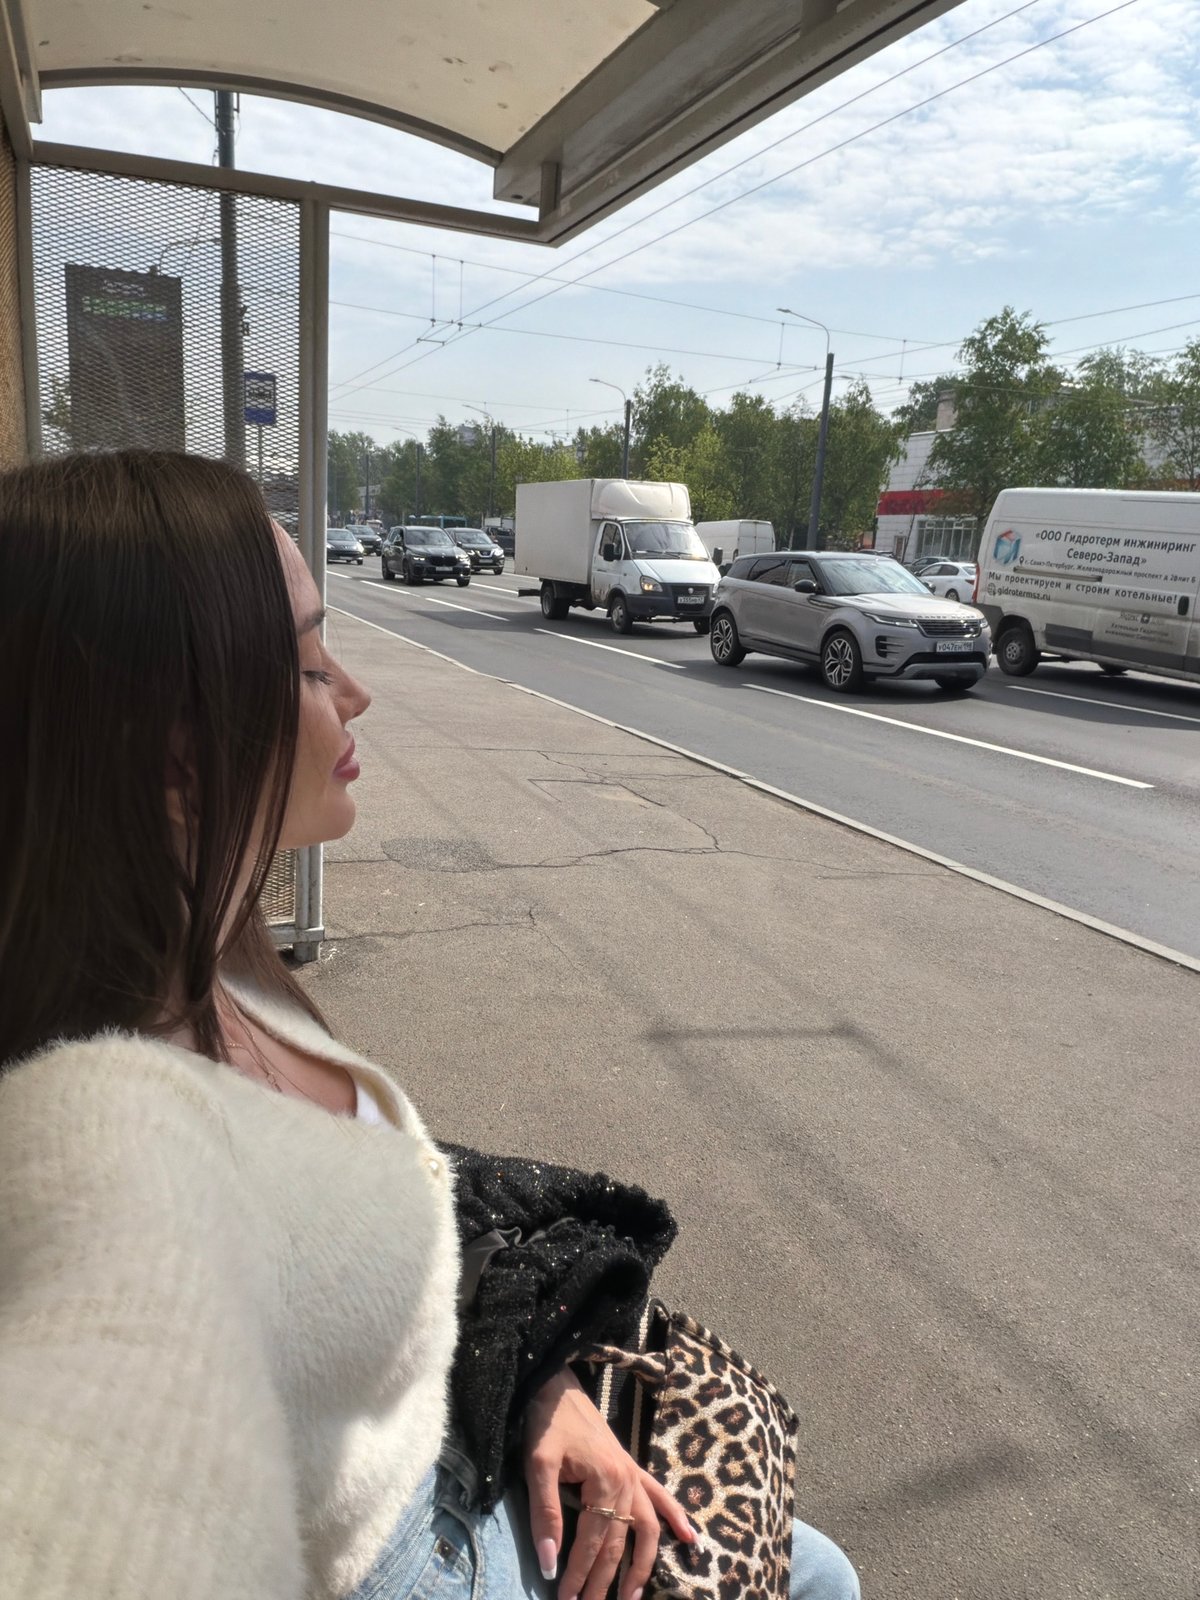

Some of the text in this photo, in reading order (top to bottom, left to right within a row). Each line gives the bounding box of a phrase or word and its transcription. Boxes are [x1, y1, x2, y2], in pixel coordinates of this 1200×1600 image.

[1035, 529, 1196, 553] «ООО Гидротерм инжиниринг
[1066, 548, 1147, 567] Северо-Запад»
[1076, 566, 1132, 576] Железнодорожный
[1133, 571, 1163, 580] проспект
[988, 571, 1001, 580] Мы
[1004, 574, 1061, 589] проектируем
[1075, 583, 1110, 594] строим
[1114, 589, 1177, 604] котельные!
